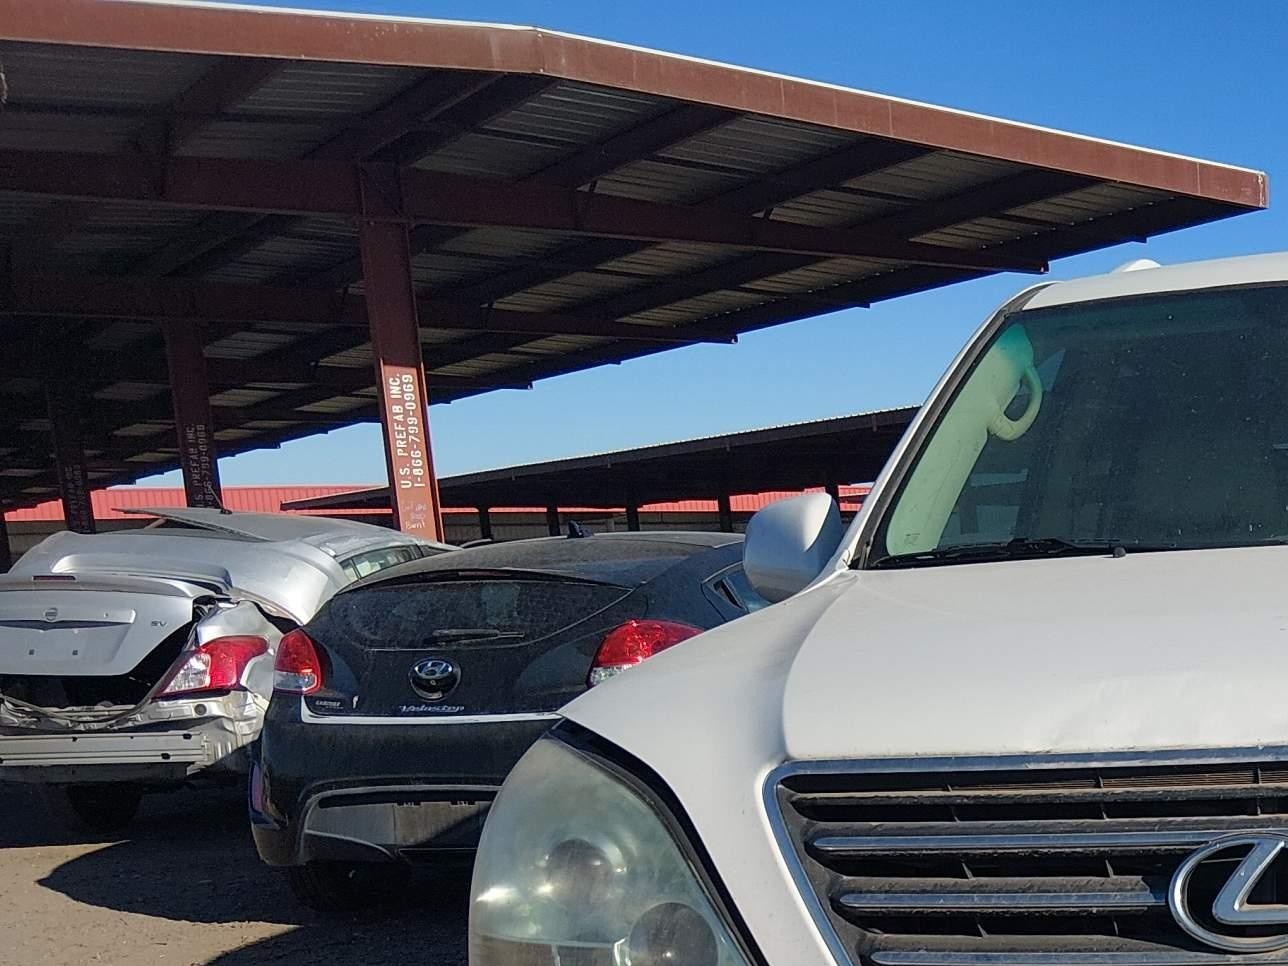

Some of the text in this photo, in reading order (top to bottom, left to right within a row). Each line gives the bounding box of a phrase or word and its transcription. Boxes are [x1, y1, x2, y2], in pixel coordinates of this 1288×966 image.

[389, 373, 412, 489] U.S. PREFAB INC.
[402, 374, 425, 488] 1-866-799-0969
